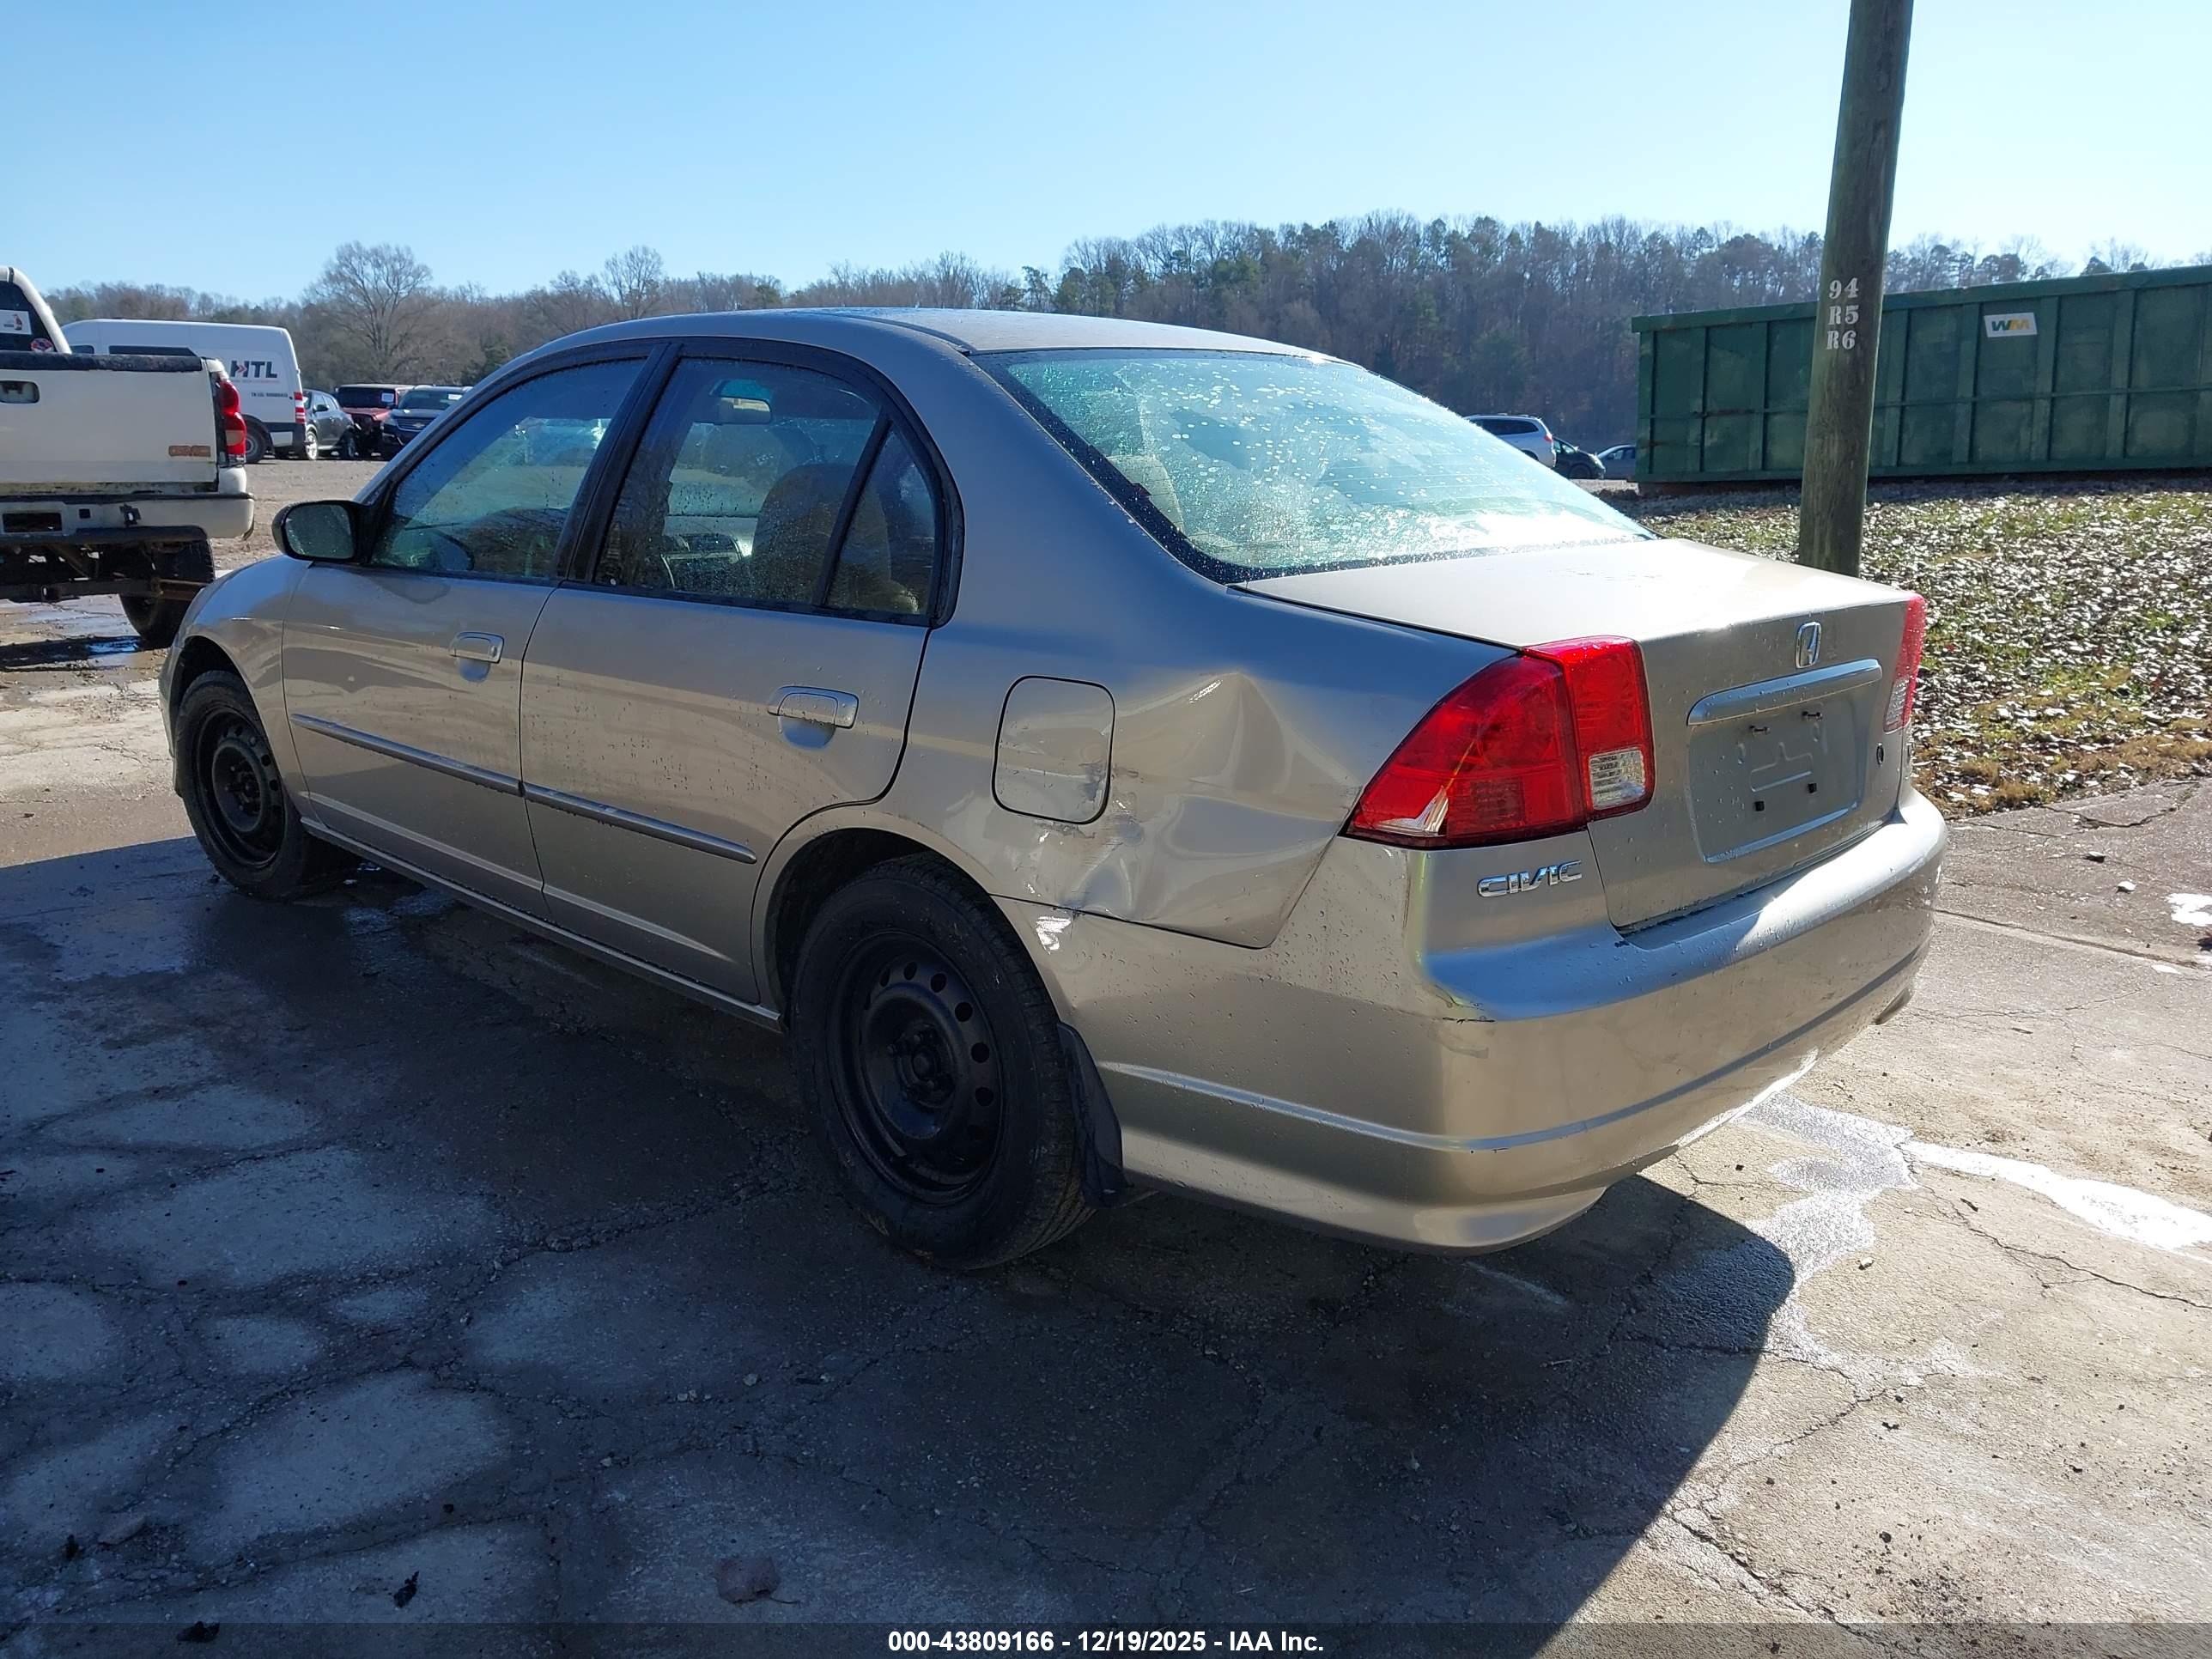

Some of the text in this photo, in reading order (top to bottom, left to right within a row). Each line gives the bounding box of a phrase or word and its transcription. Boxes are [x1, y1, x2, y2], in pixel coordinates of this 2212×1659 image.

[1828, 277, 1859, 299] 94
[1827, 304, 1859, 325] R5
[1991, 319, 2030, 331] WM
[1826, 330, 1856, 349] R6
[1477, 860, 1583, 897] CIVIC
